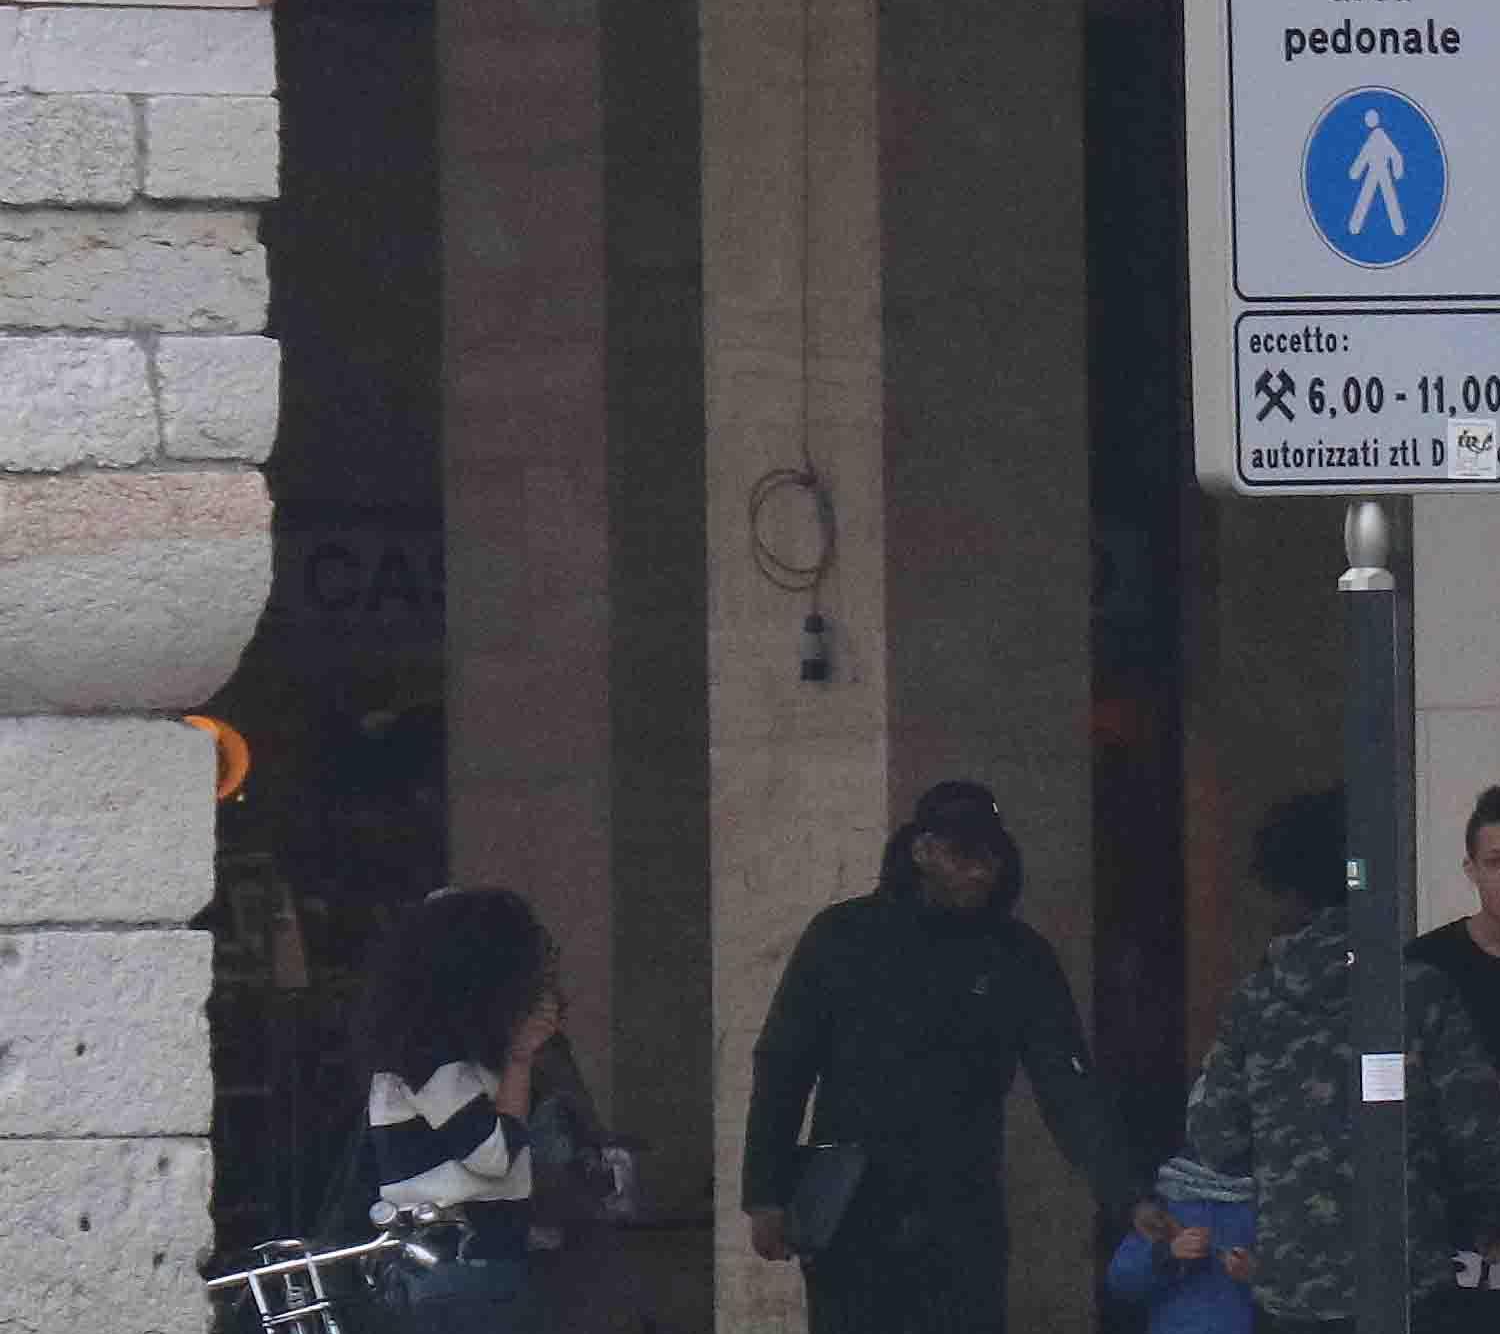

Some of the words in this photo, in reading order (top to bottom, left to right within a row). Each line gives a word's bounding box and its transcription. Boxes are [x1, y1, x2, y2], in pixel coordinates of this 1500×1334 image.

[1284, 18, 1461, 62] pedonale
[1250, 326, 1350, 353] eccetto:
[1308, 376, 1384, 418] 6,00
[1251, 438, 1379, 469] autorizzati
[1389, 437, 1420, 467] ztl
